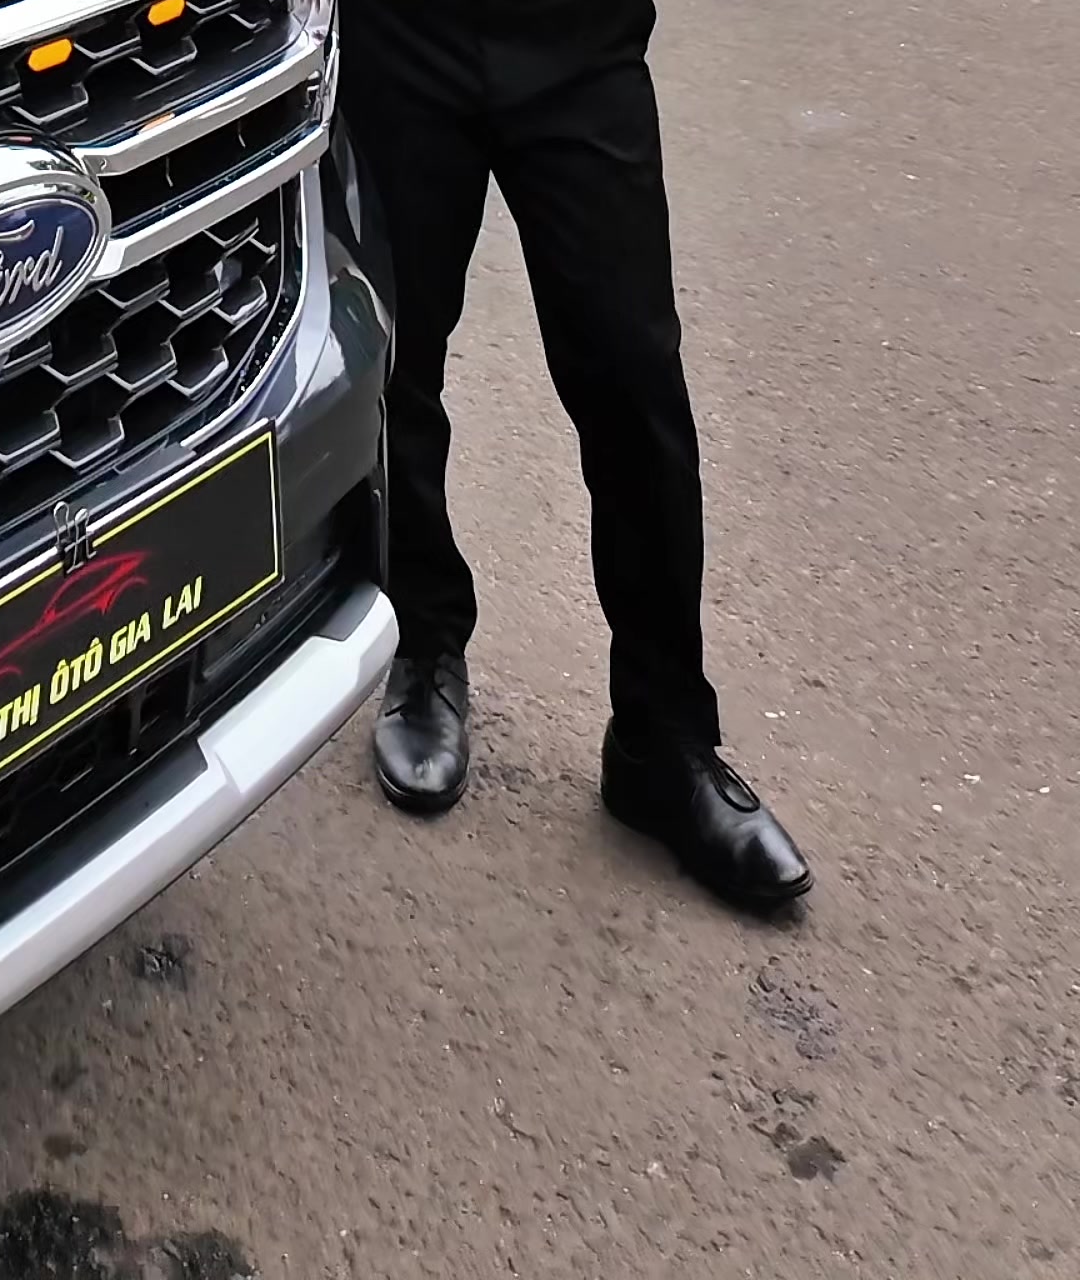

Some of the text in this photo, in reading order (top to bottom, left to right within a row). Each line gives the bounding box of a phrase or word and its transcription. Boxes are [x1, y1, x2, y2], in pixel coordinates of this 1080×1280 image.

[49, 636, 103, 705] ÔTÔ
[109, 611, 151, 665] GIA
[162, 575, 202, 630] LAI
